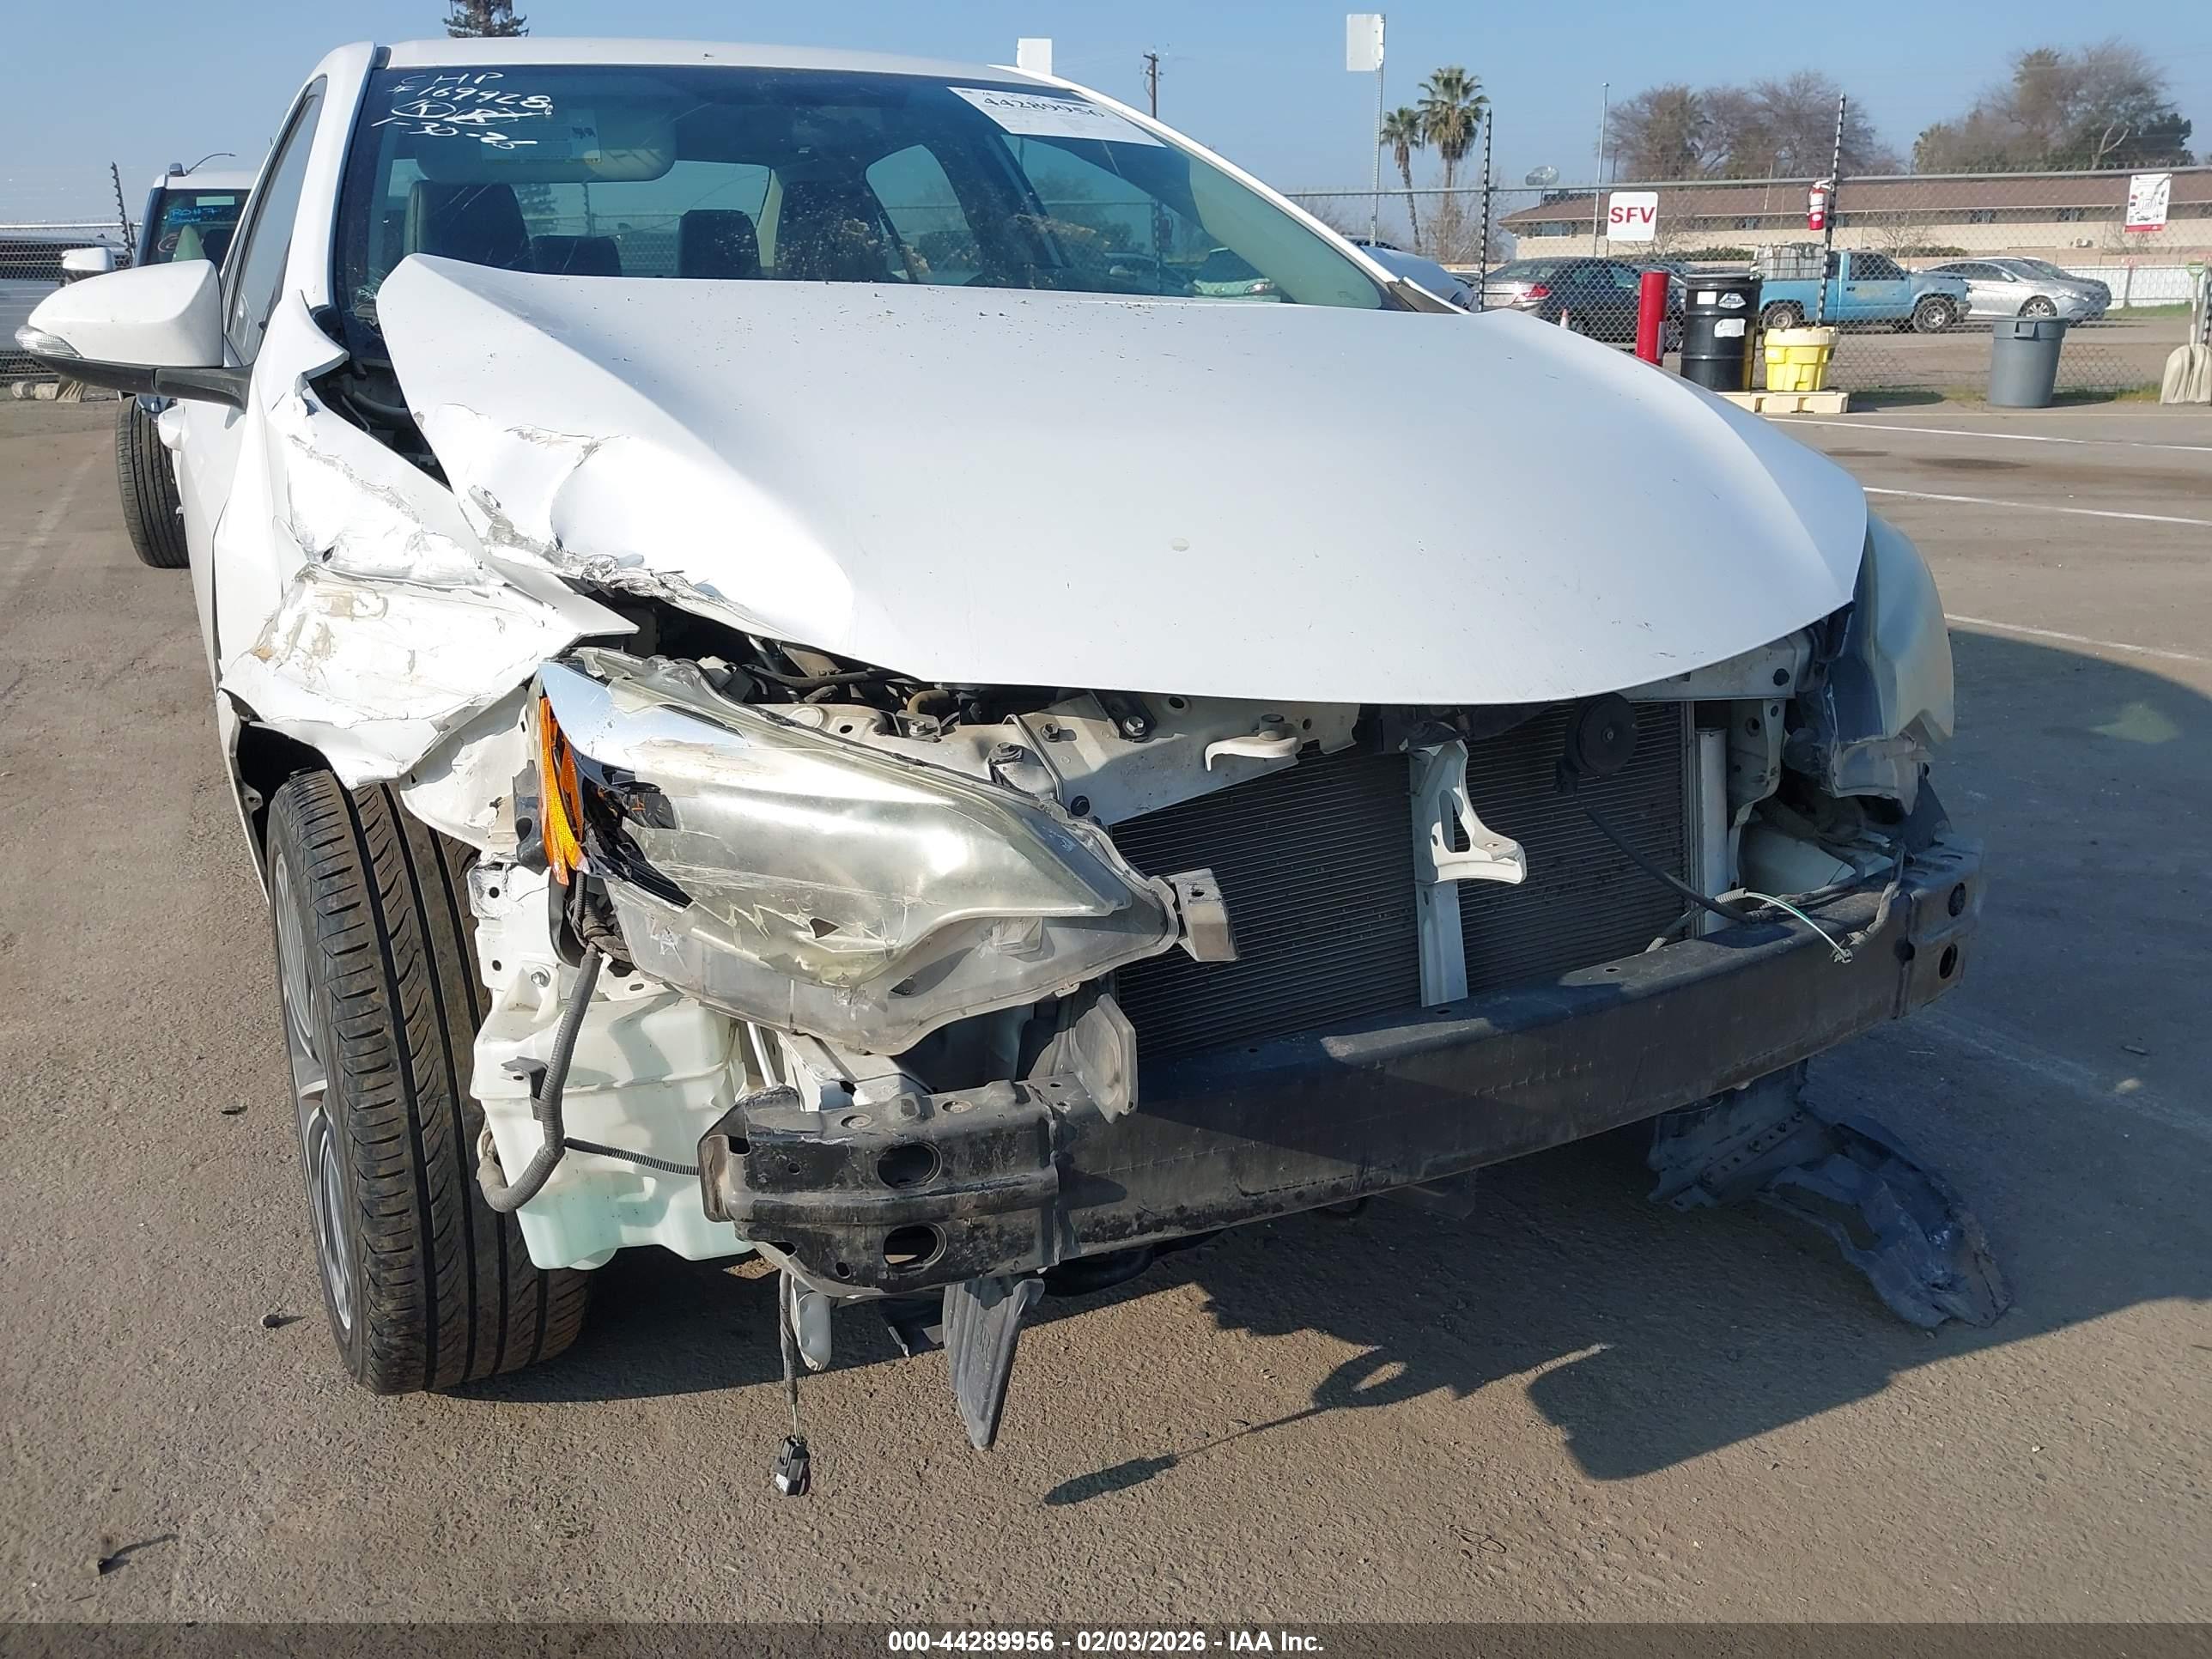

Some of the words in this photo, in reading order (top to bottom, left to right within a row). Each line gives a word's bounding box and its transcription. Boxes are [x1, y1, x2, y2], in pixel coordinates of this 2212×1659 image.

[401, 72, 504, 85] CHP
[984, 97, 1106, 118] 44289956
[1610, 207, 1656, 223] SFV
